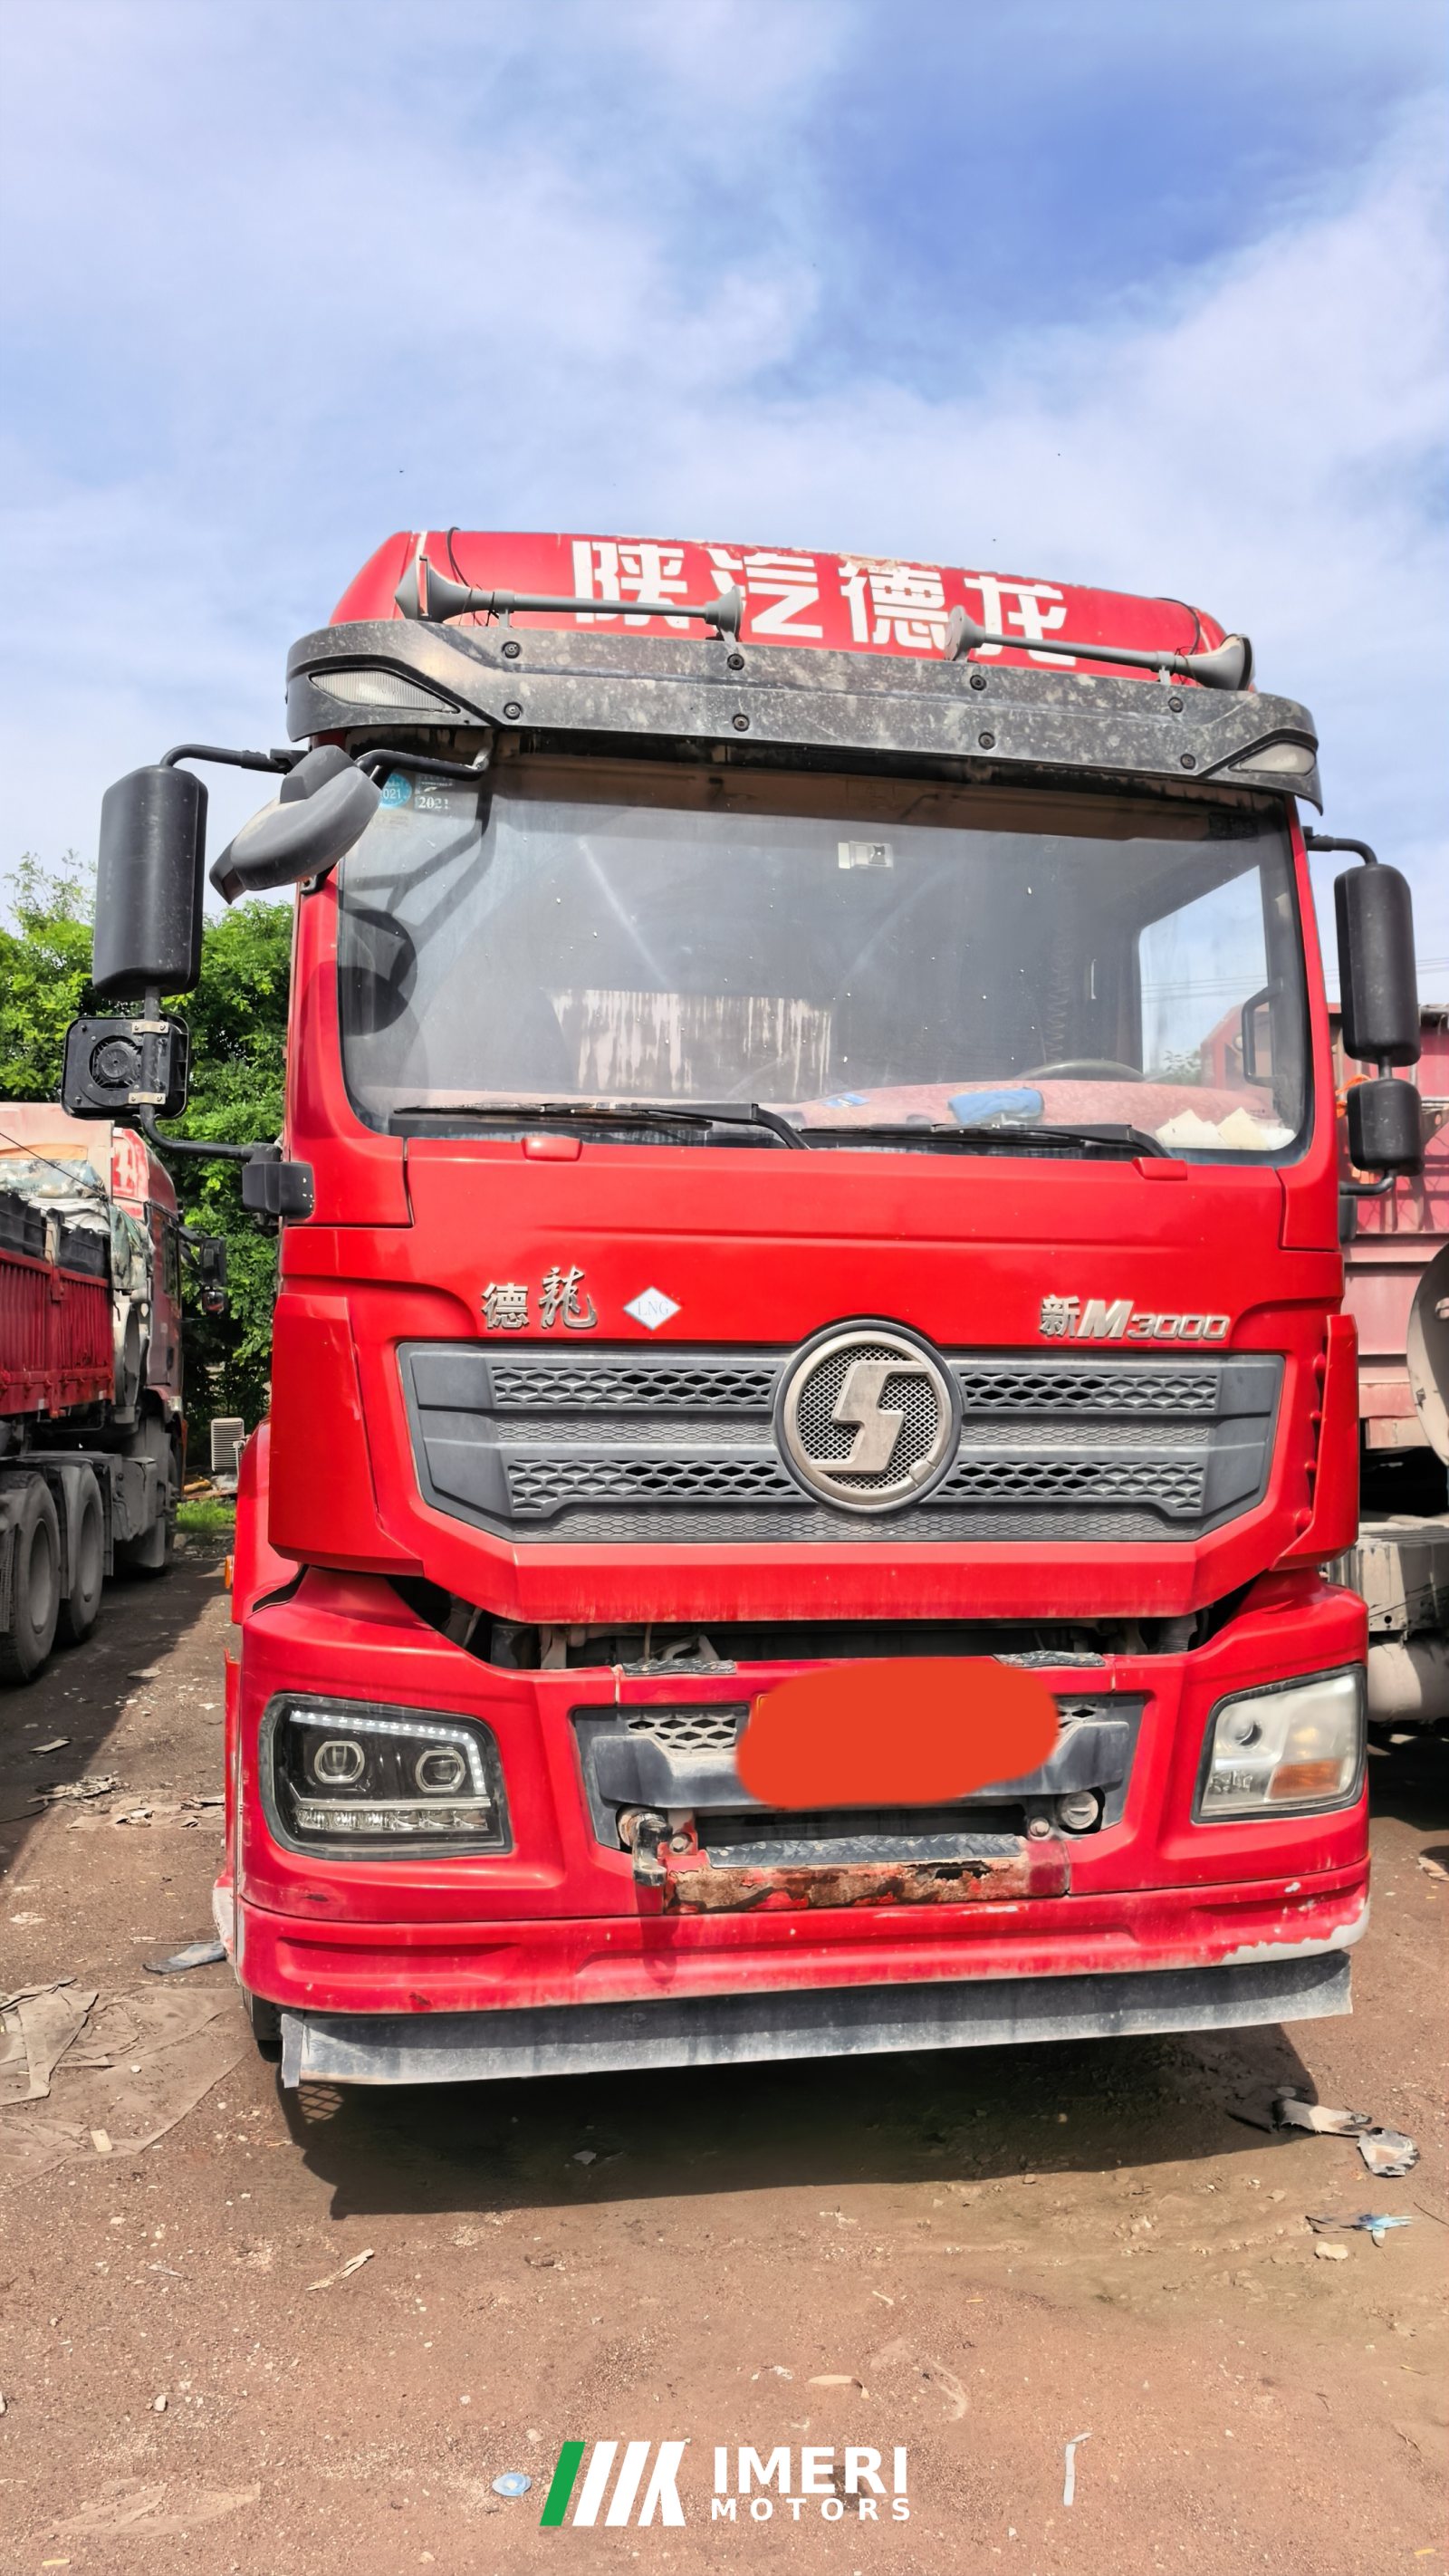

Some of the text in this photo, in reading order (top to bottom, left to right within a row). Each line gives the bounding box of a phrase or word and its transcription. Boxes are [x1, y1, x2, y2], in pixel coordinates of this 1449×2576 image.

[571, 540, 1077, 667] 陕汽德龙
[379, 787, 402, 801] 021
[417, 796, 450, 810] 2021
[637, 1300, 669, 1316] LNG
